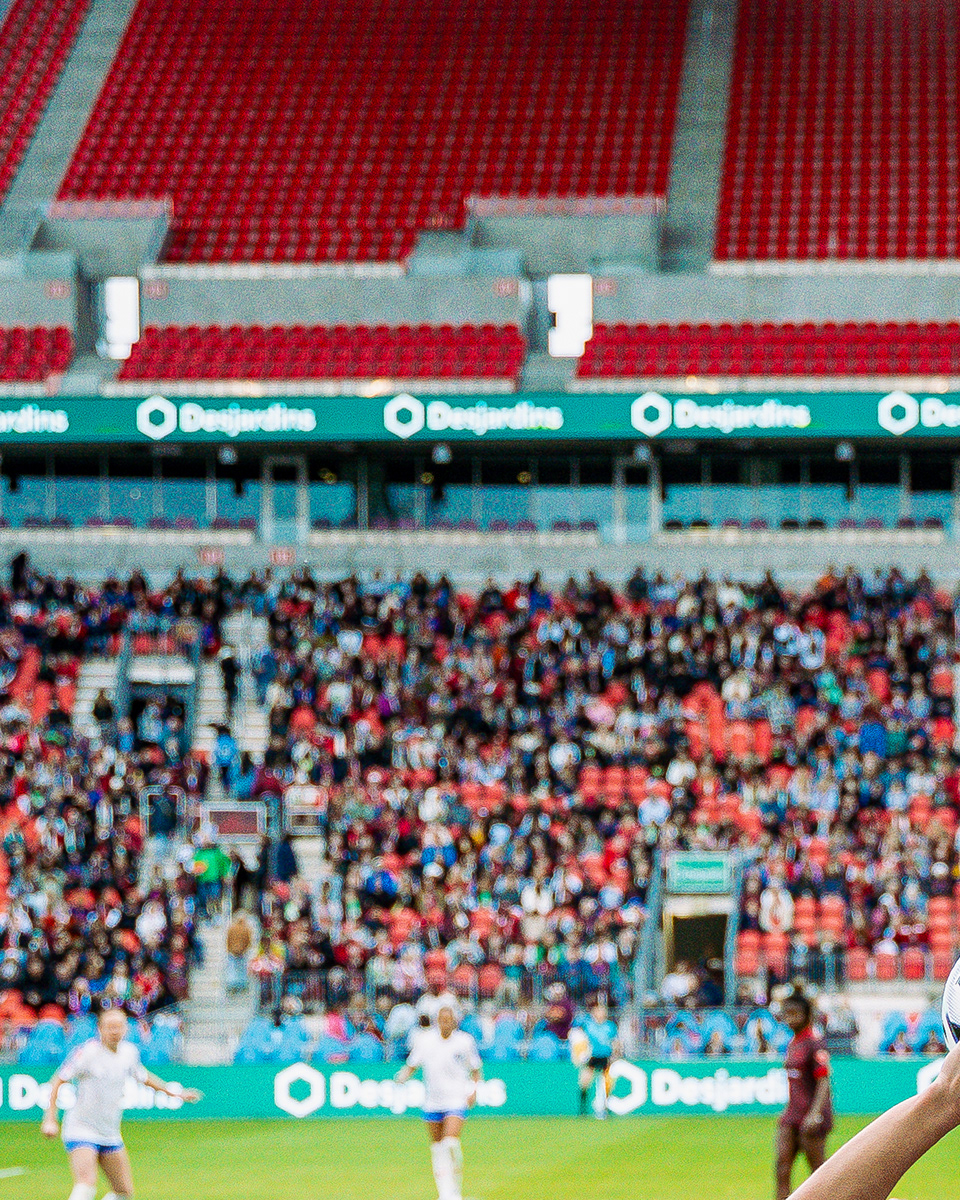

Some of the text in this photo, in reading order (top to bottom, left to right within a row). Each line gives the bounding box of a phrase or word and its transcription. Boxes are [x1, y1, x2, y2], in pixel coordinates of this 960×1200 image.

[181, 403, 317, 438] Desjardins
[428, 402, 564, 437] Desjardins
[675, 400, 811, 435] Desjardins
